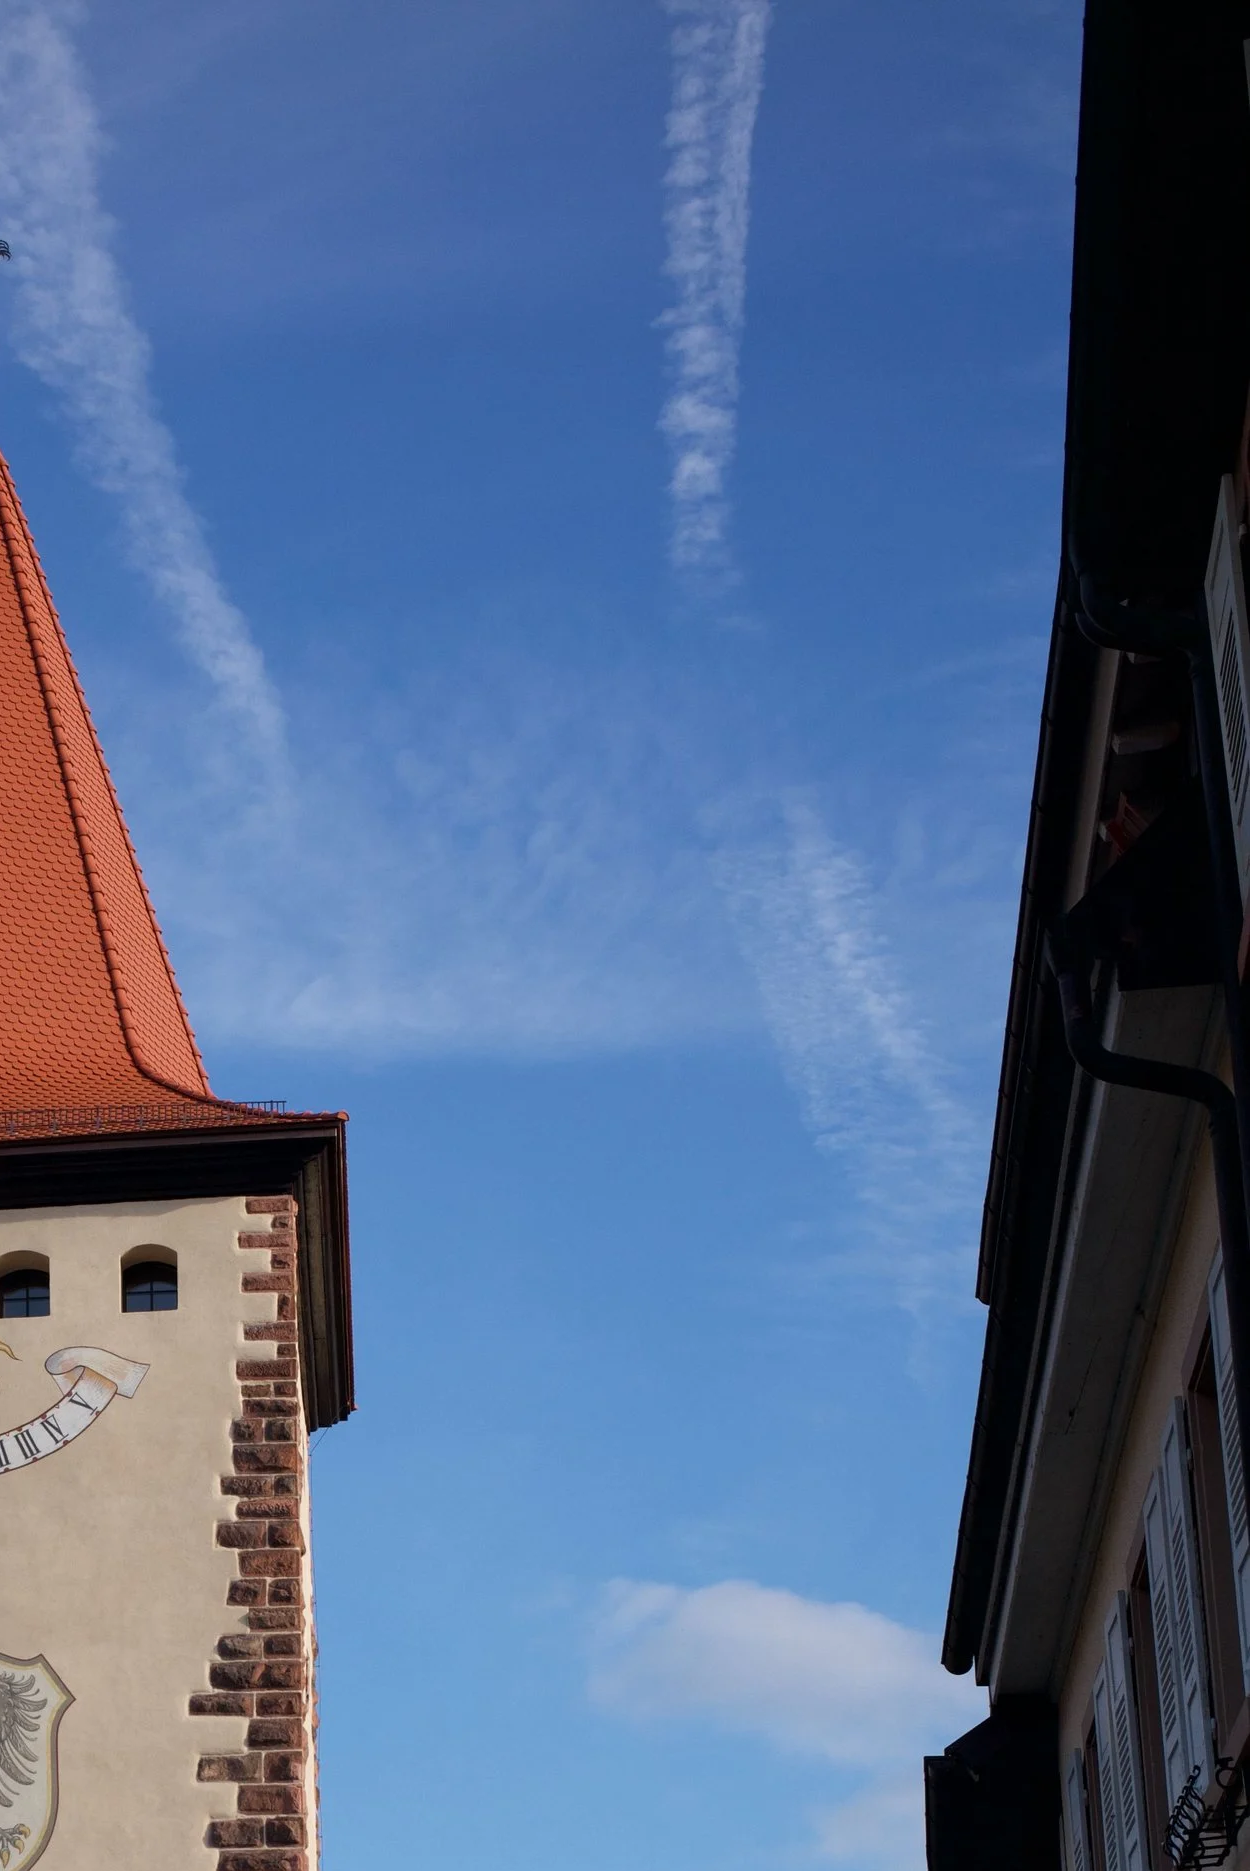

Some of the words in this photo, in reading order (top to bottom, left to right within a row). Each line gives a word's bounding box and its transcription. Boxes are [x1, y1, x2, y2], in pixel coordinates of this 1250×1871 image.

[14, 1429, 41, 1460] III
[40, 1414, 69, 1445] IV
[69, 1392, 98, 1416] V
